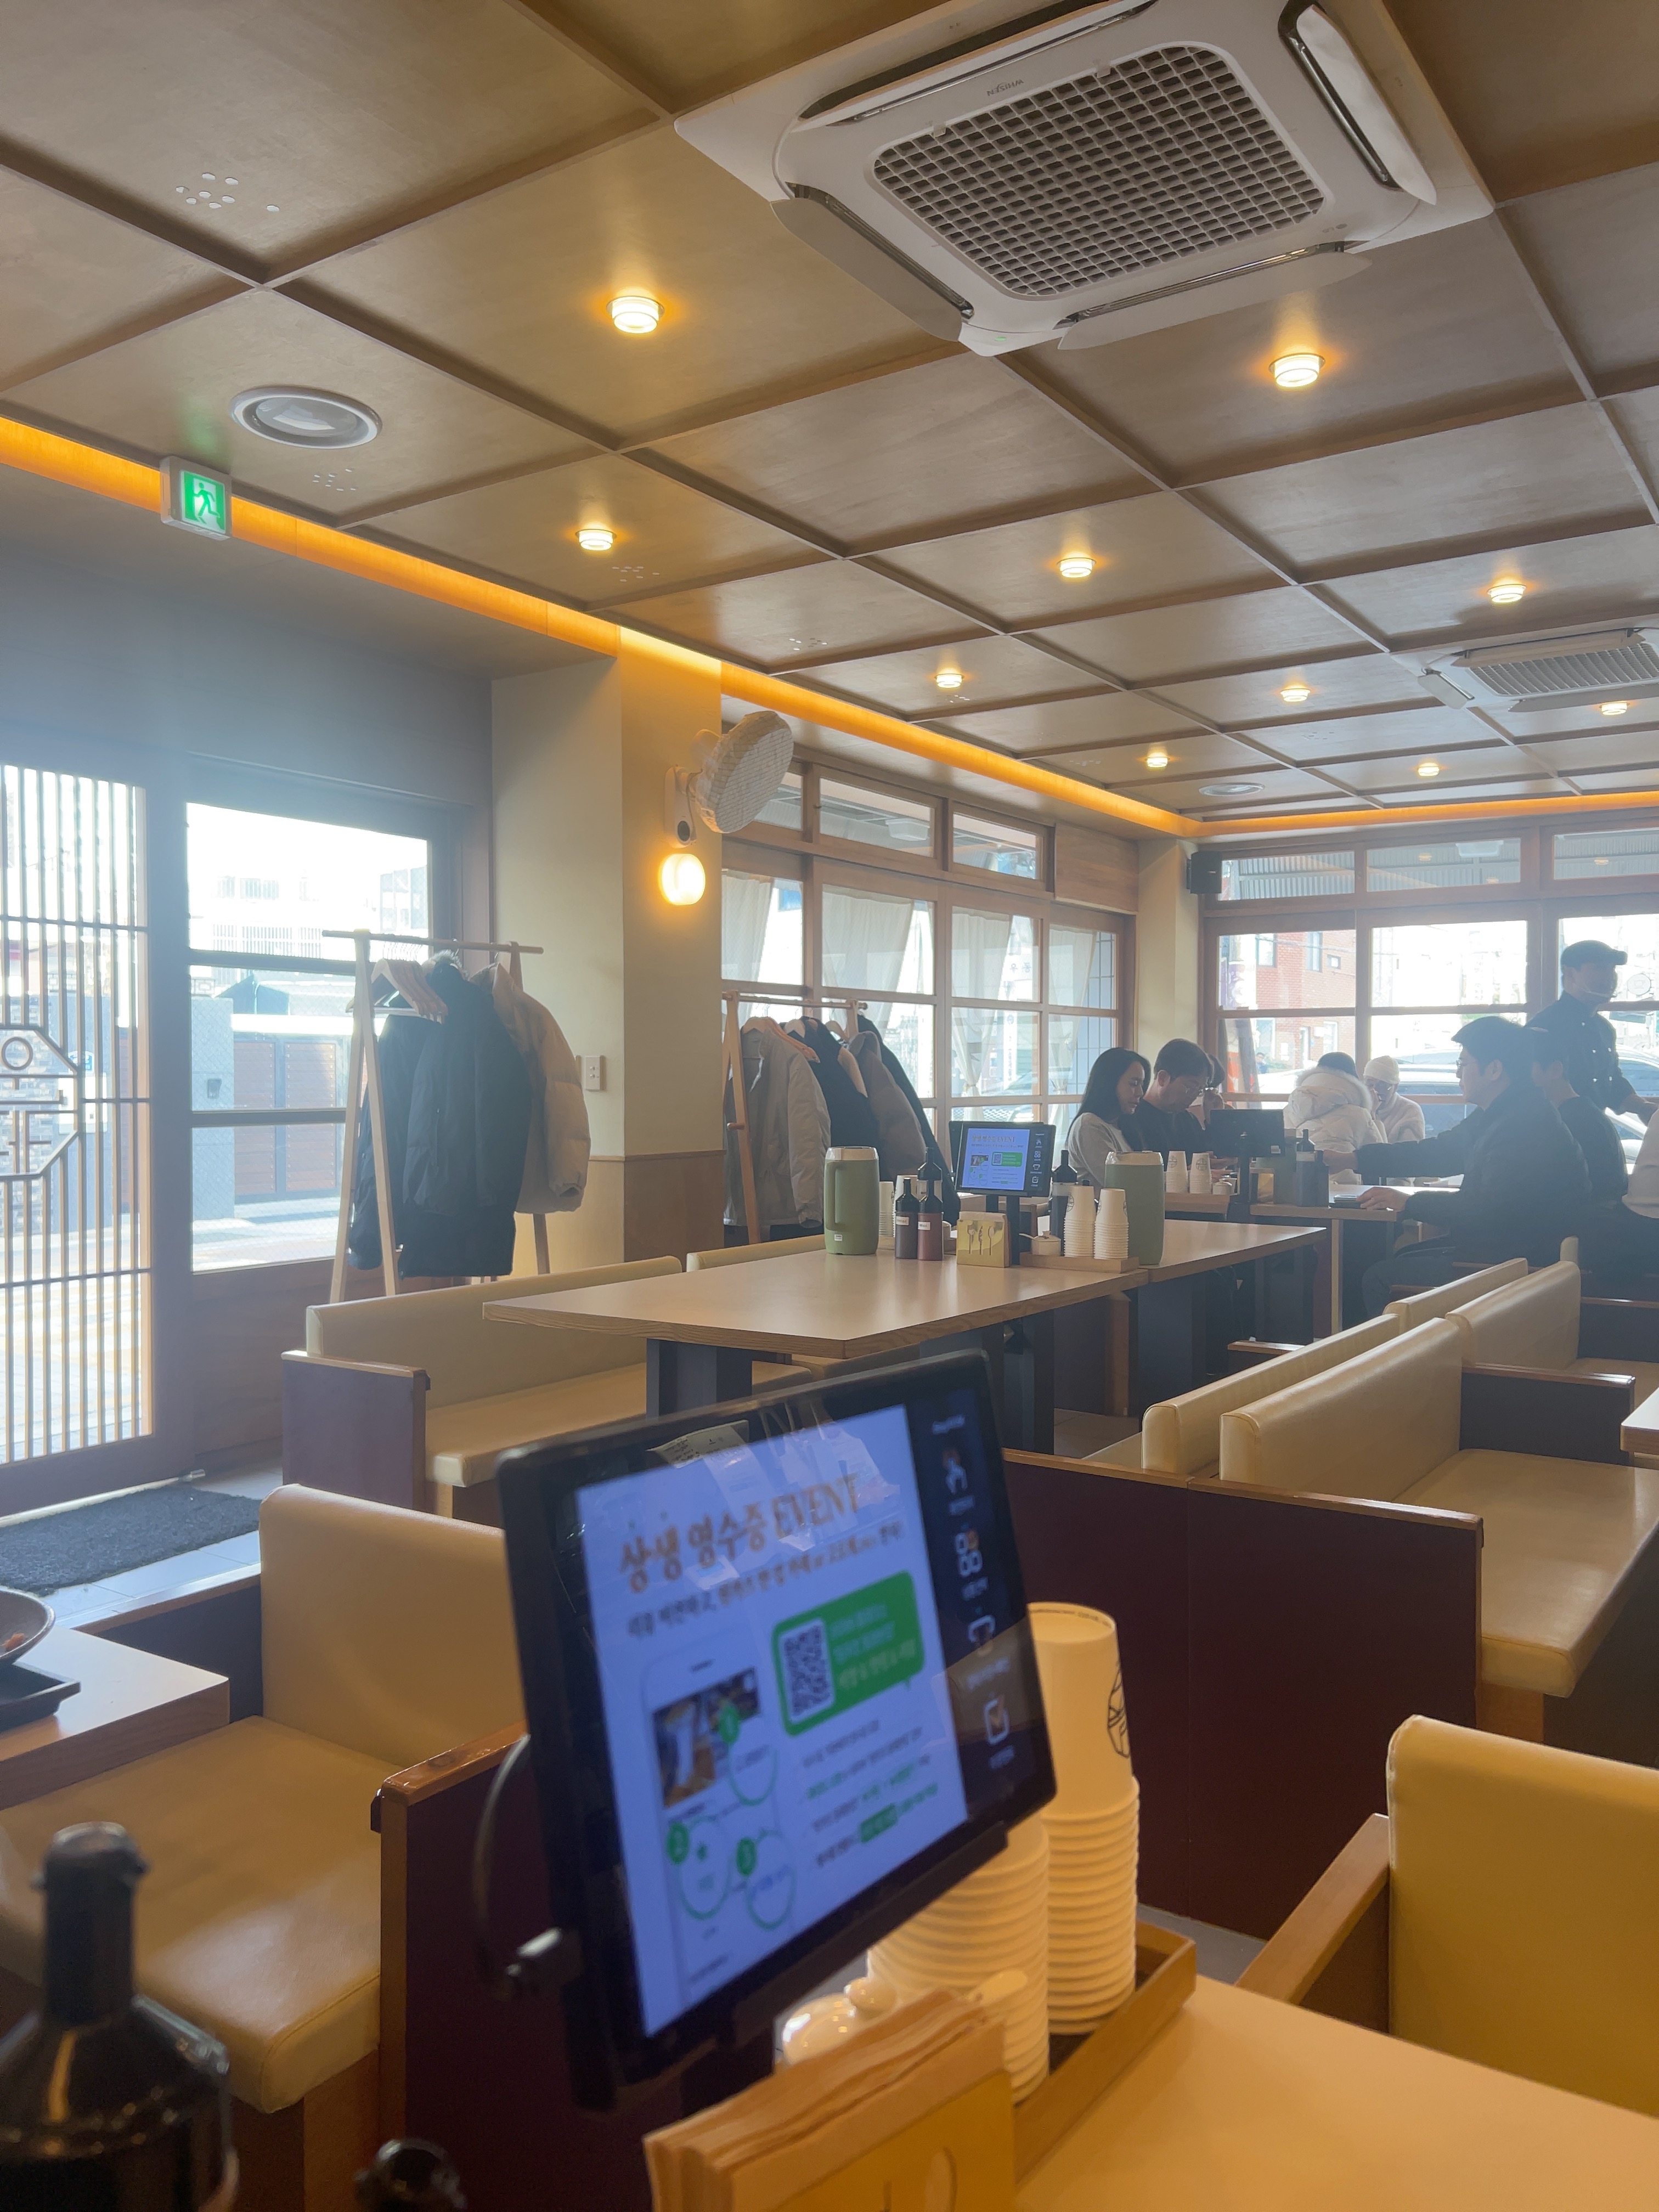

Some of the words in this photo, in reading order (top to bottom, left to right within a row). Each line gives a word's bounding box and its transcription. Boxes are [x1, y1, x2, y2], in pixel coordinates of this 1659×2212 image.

[986, 79, 1024, 96] WHISEN
[687, 1502, 767, 1569] 영수증
[771, 1474, 860, 1540] EVENT
